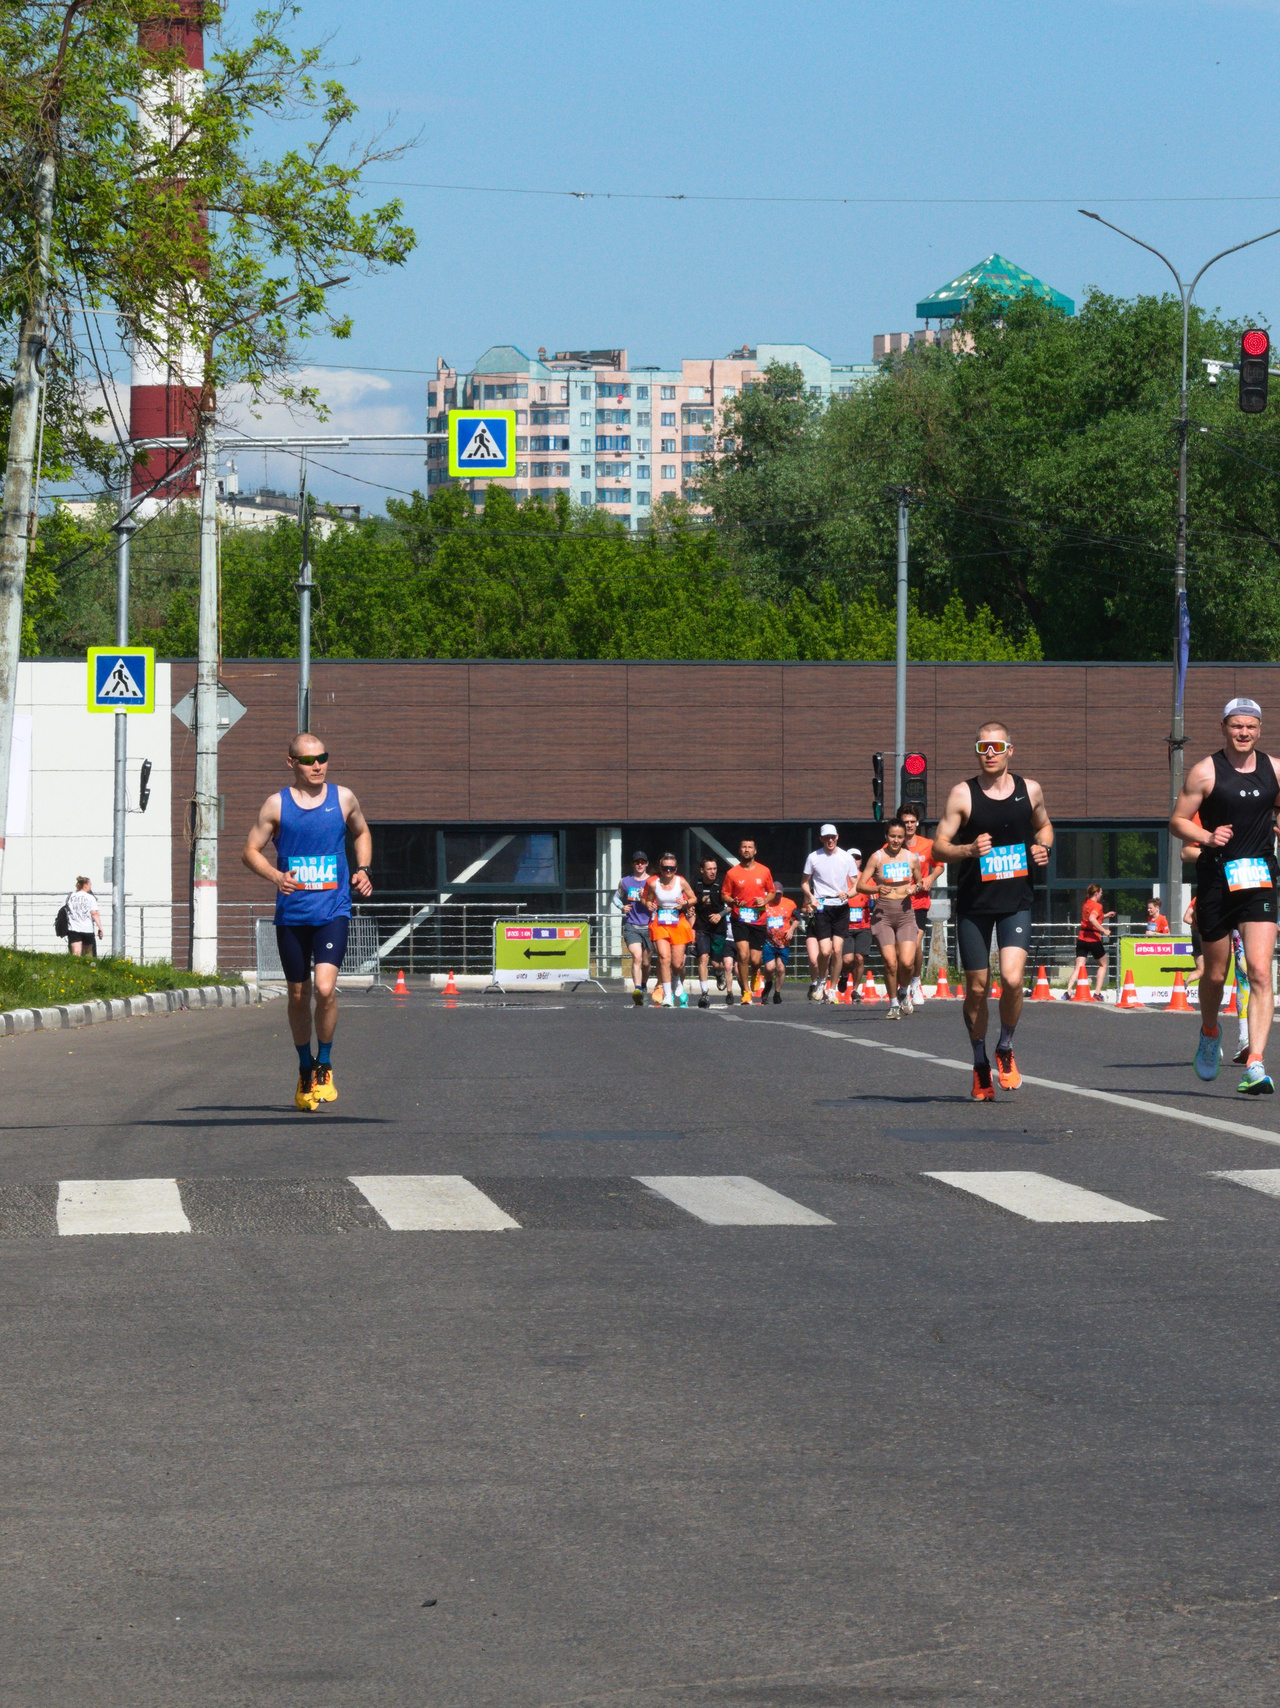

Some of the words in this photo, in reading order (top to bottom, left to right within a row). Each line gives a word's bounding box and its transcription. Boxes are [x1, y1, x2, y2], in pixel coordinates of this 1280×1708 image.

[985, 853, 1022, 873] 70112
[291, 864, 334, 882] 70044
[1229, 865, 1267, 883] 70103
